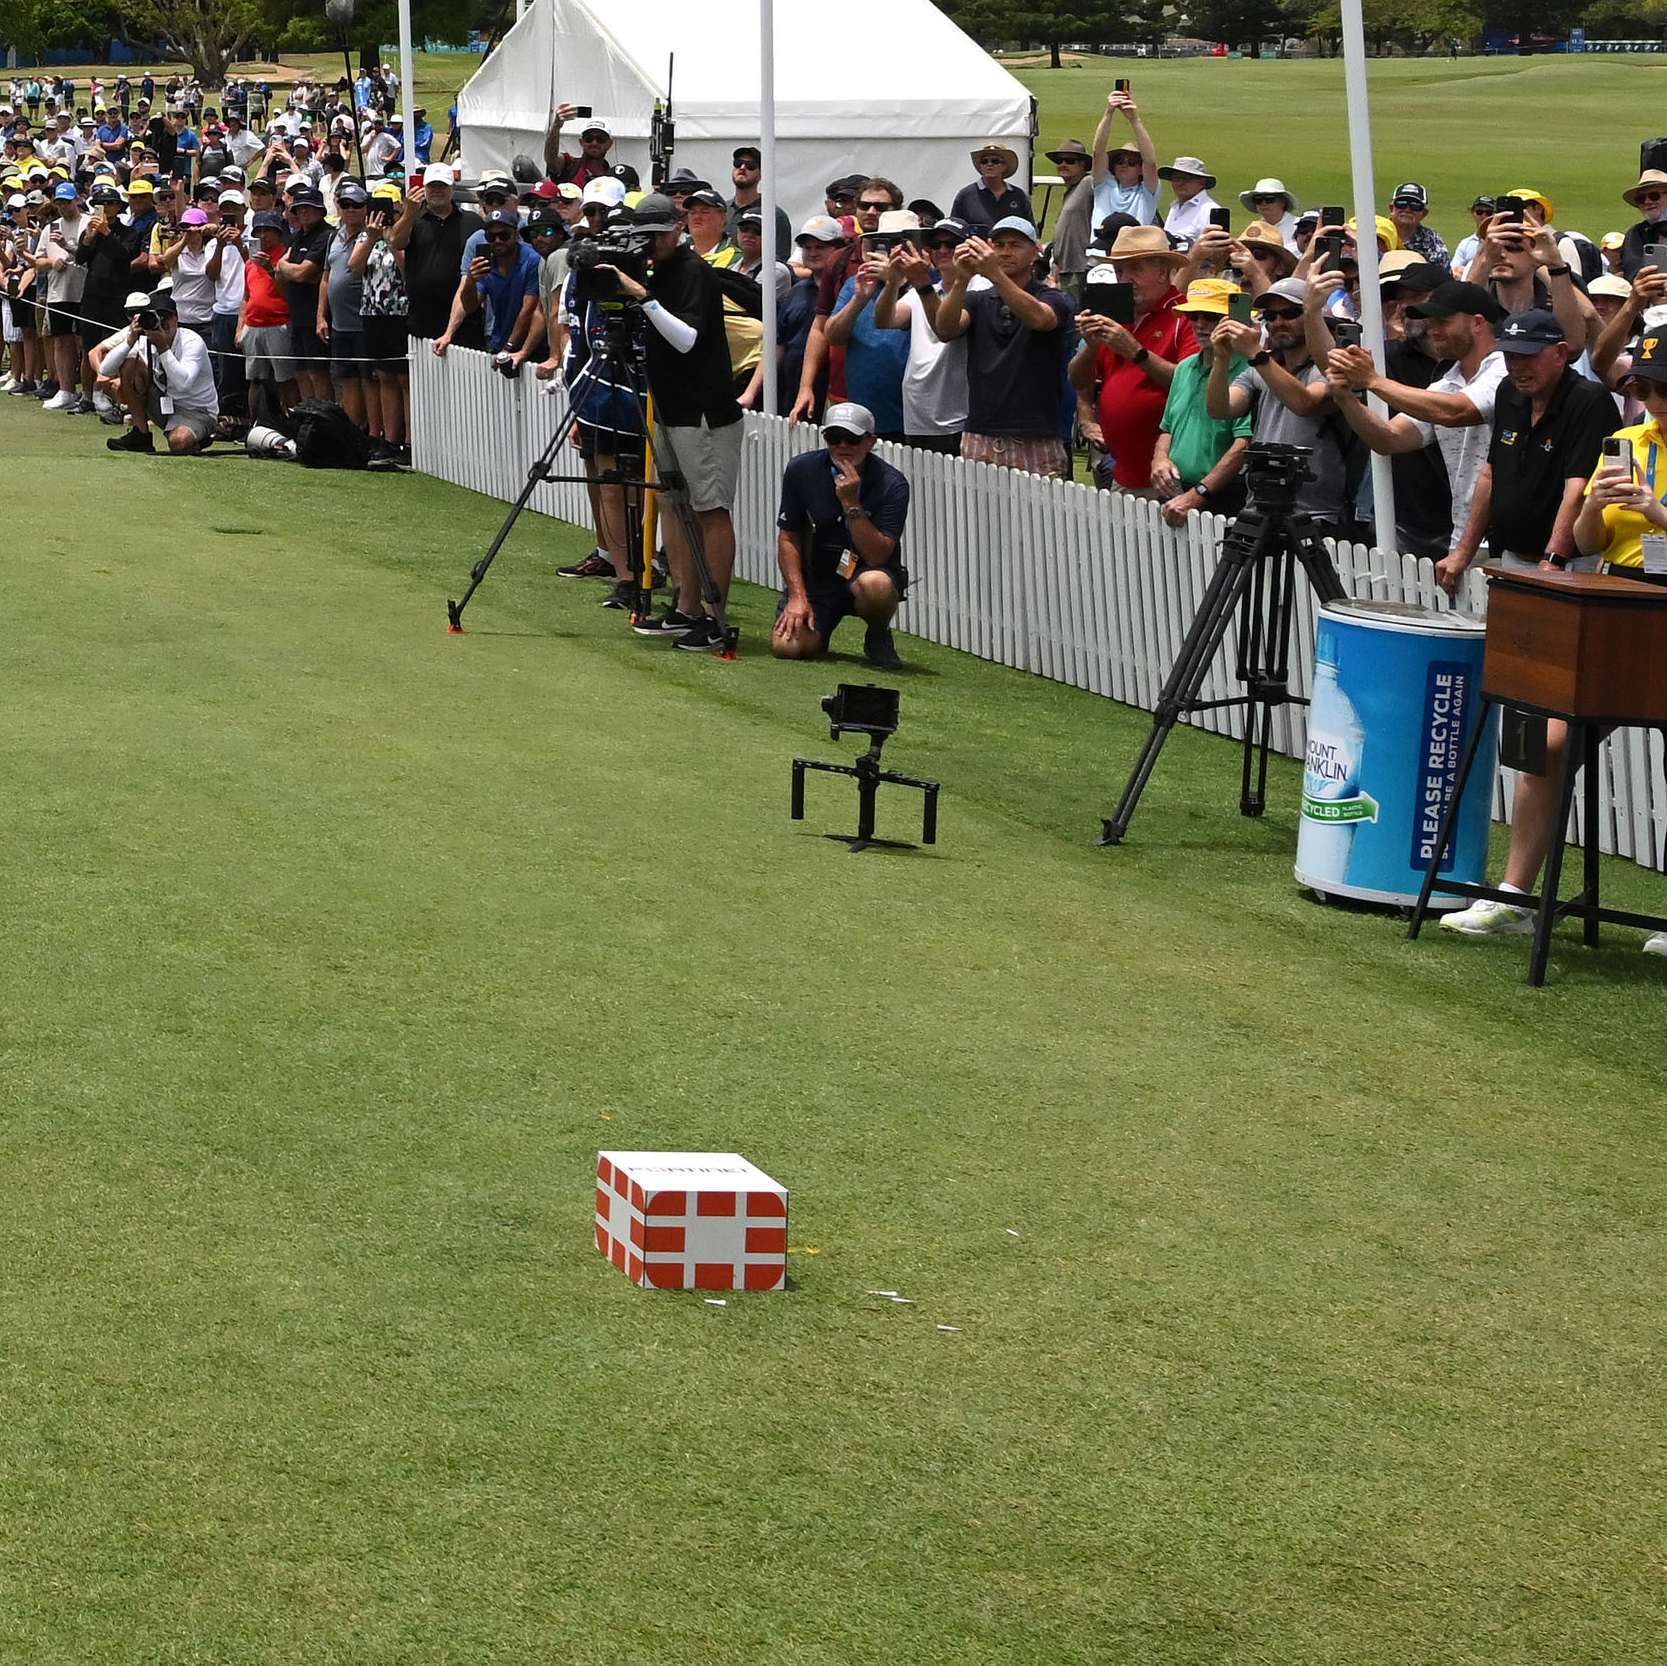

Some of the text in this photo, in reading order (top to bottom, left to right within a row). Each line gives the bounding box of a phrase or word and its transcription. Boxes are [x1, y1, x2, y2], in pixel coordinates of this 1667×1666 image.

[1452, 675, 1465, 717] AGAIN
[1308, 740, 1337, 760] OUNT
[1447, 719, 1460, 769] BOTTLE
[1421, 674, 1452, 859] PLEASE RECYCLE
[1302, 801, 1340, 817] ECYCLED
